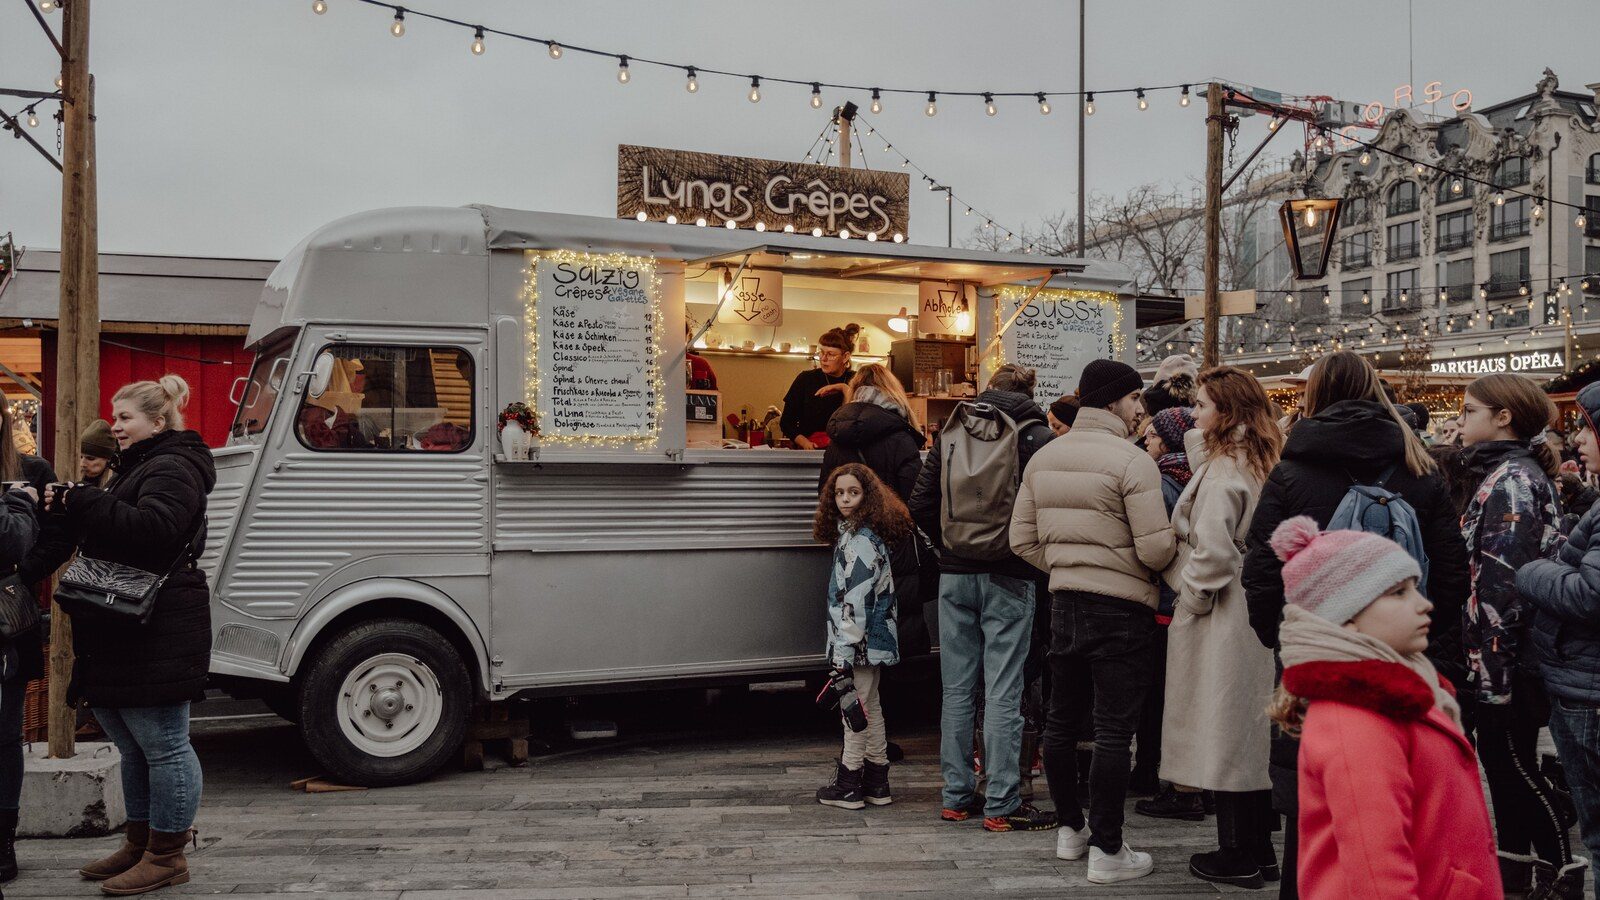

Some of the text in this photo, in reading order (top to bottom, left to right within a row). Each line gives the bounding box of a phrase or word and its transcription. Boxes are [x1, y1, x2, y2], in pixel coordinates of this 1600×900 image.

[1341, 81, 1473, 146] CORSO
[643, 165, 891, 236] Lunas Crêpes
[552, 262, 640, 289] Salzig
[555, 285, 603, 301] Crêpes
[552, 306, 652, 322] Käse 12
[552, 318, 575, 328] Käse
[584, 319, 604, 330] Pesto
[1016, 316, 1055, 330] Crêpes
[552, 330, 575, 340] Käse
[585, 331, 617, 342] Schinken
[552, 341, 574, 350] Käse
[582, 342, 607, 353] Speck
[646, 346, 653, 354] 15
[553, 352, 588, 362] Classico
[1431, 357, 1507, 374] PARKHAUS
[552, 397, 572, 406] Total
[686, 395, 717, 406] UNAS
[554, 408, 562, 418] La
[564, 408, 584, 418] Luna
